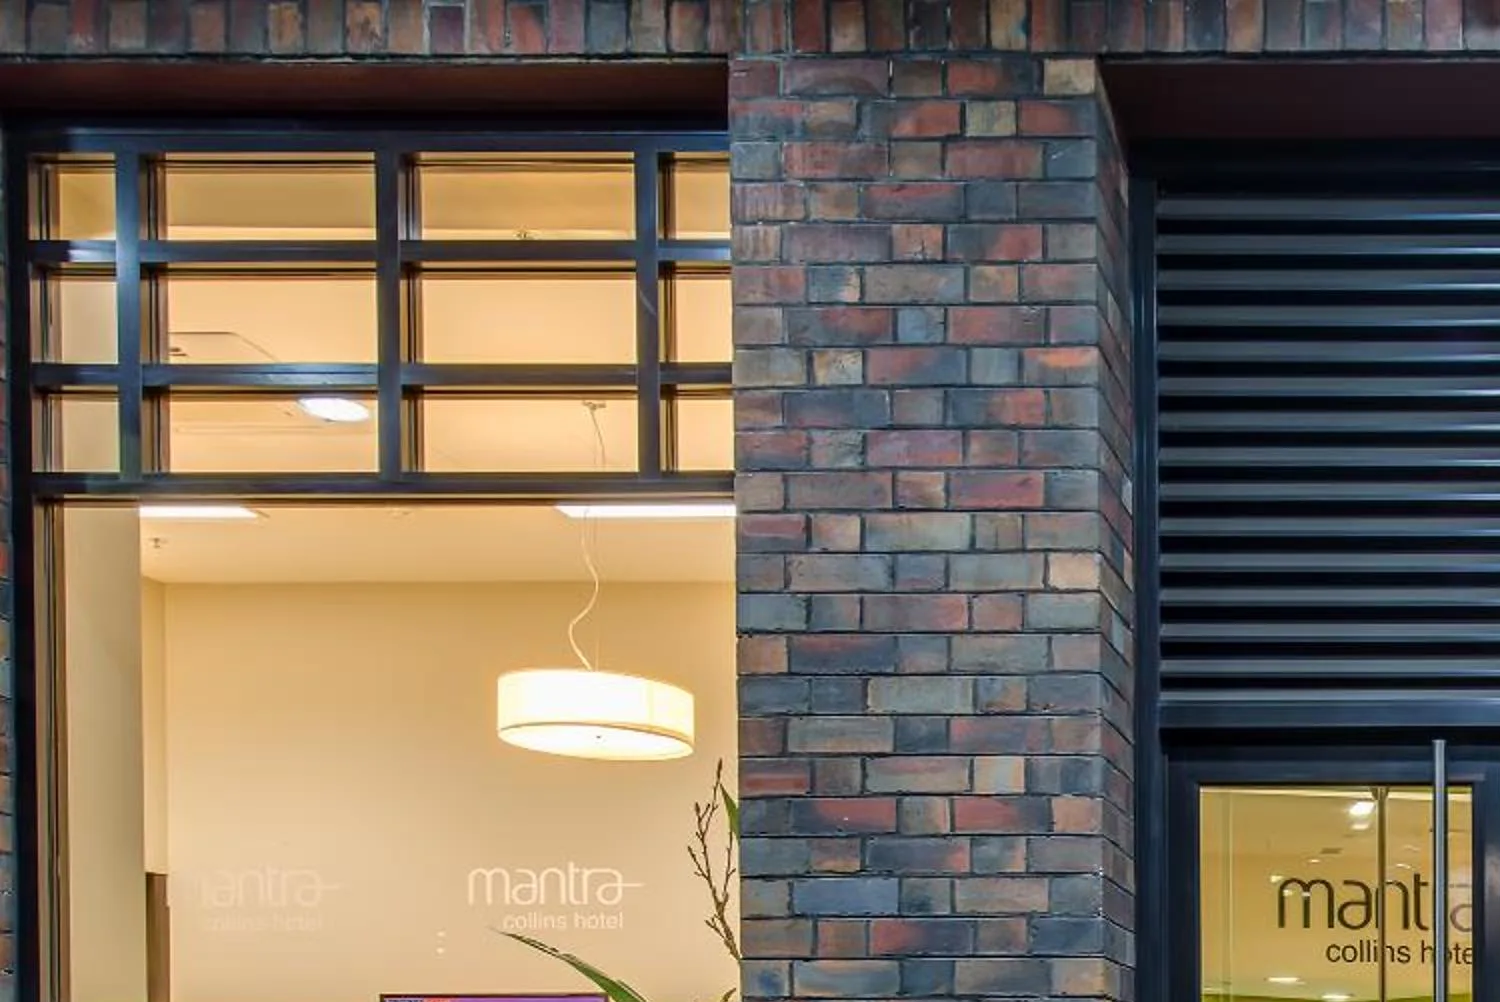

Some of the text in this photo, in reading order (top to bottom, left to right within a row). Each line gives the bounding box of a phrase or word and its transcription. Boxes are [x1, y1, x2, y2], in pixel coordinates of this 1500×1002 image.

[468, 861, 646, 906] mantra
[1278, 873, 1472, 932] manta
[503, 911, 624, 930] collins hotel
[1326, 939, 1411, 963] collins
